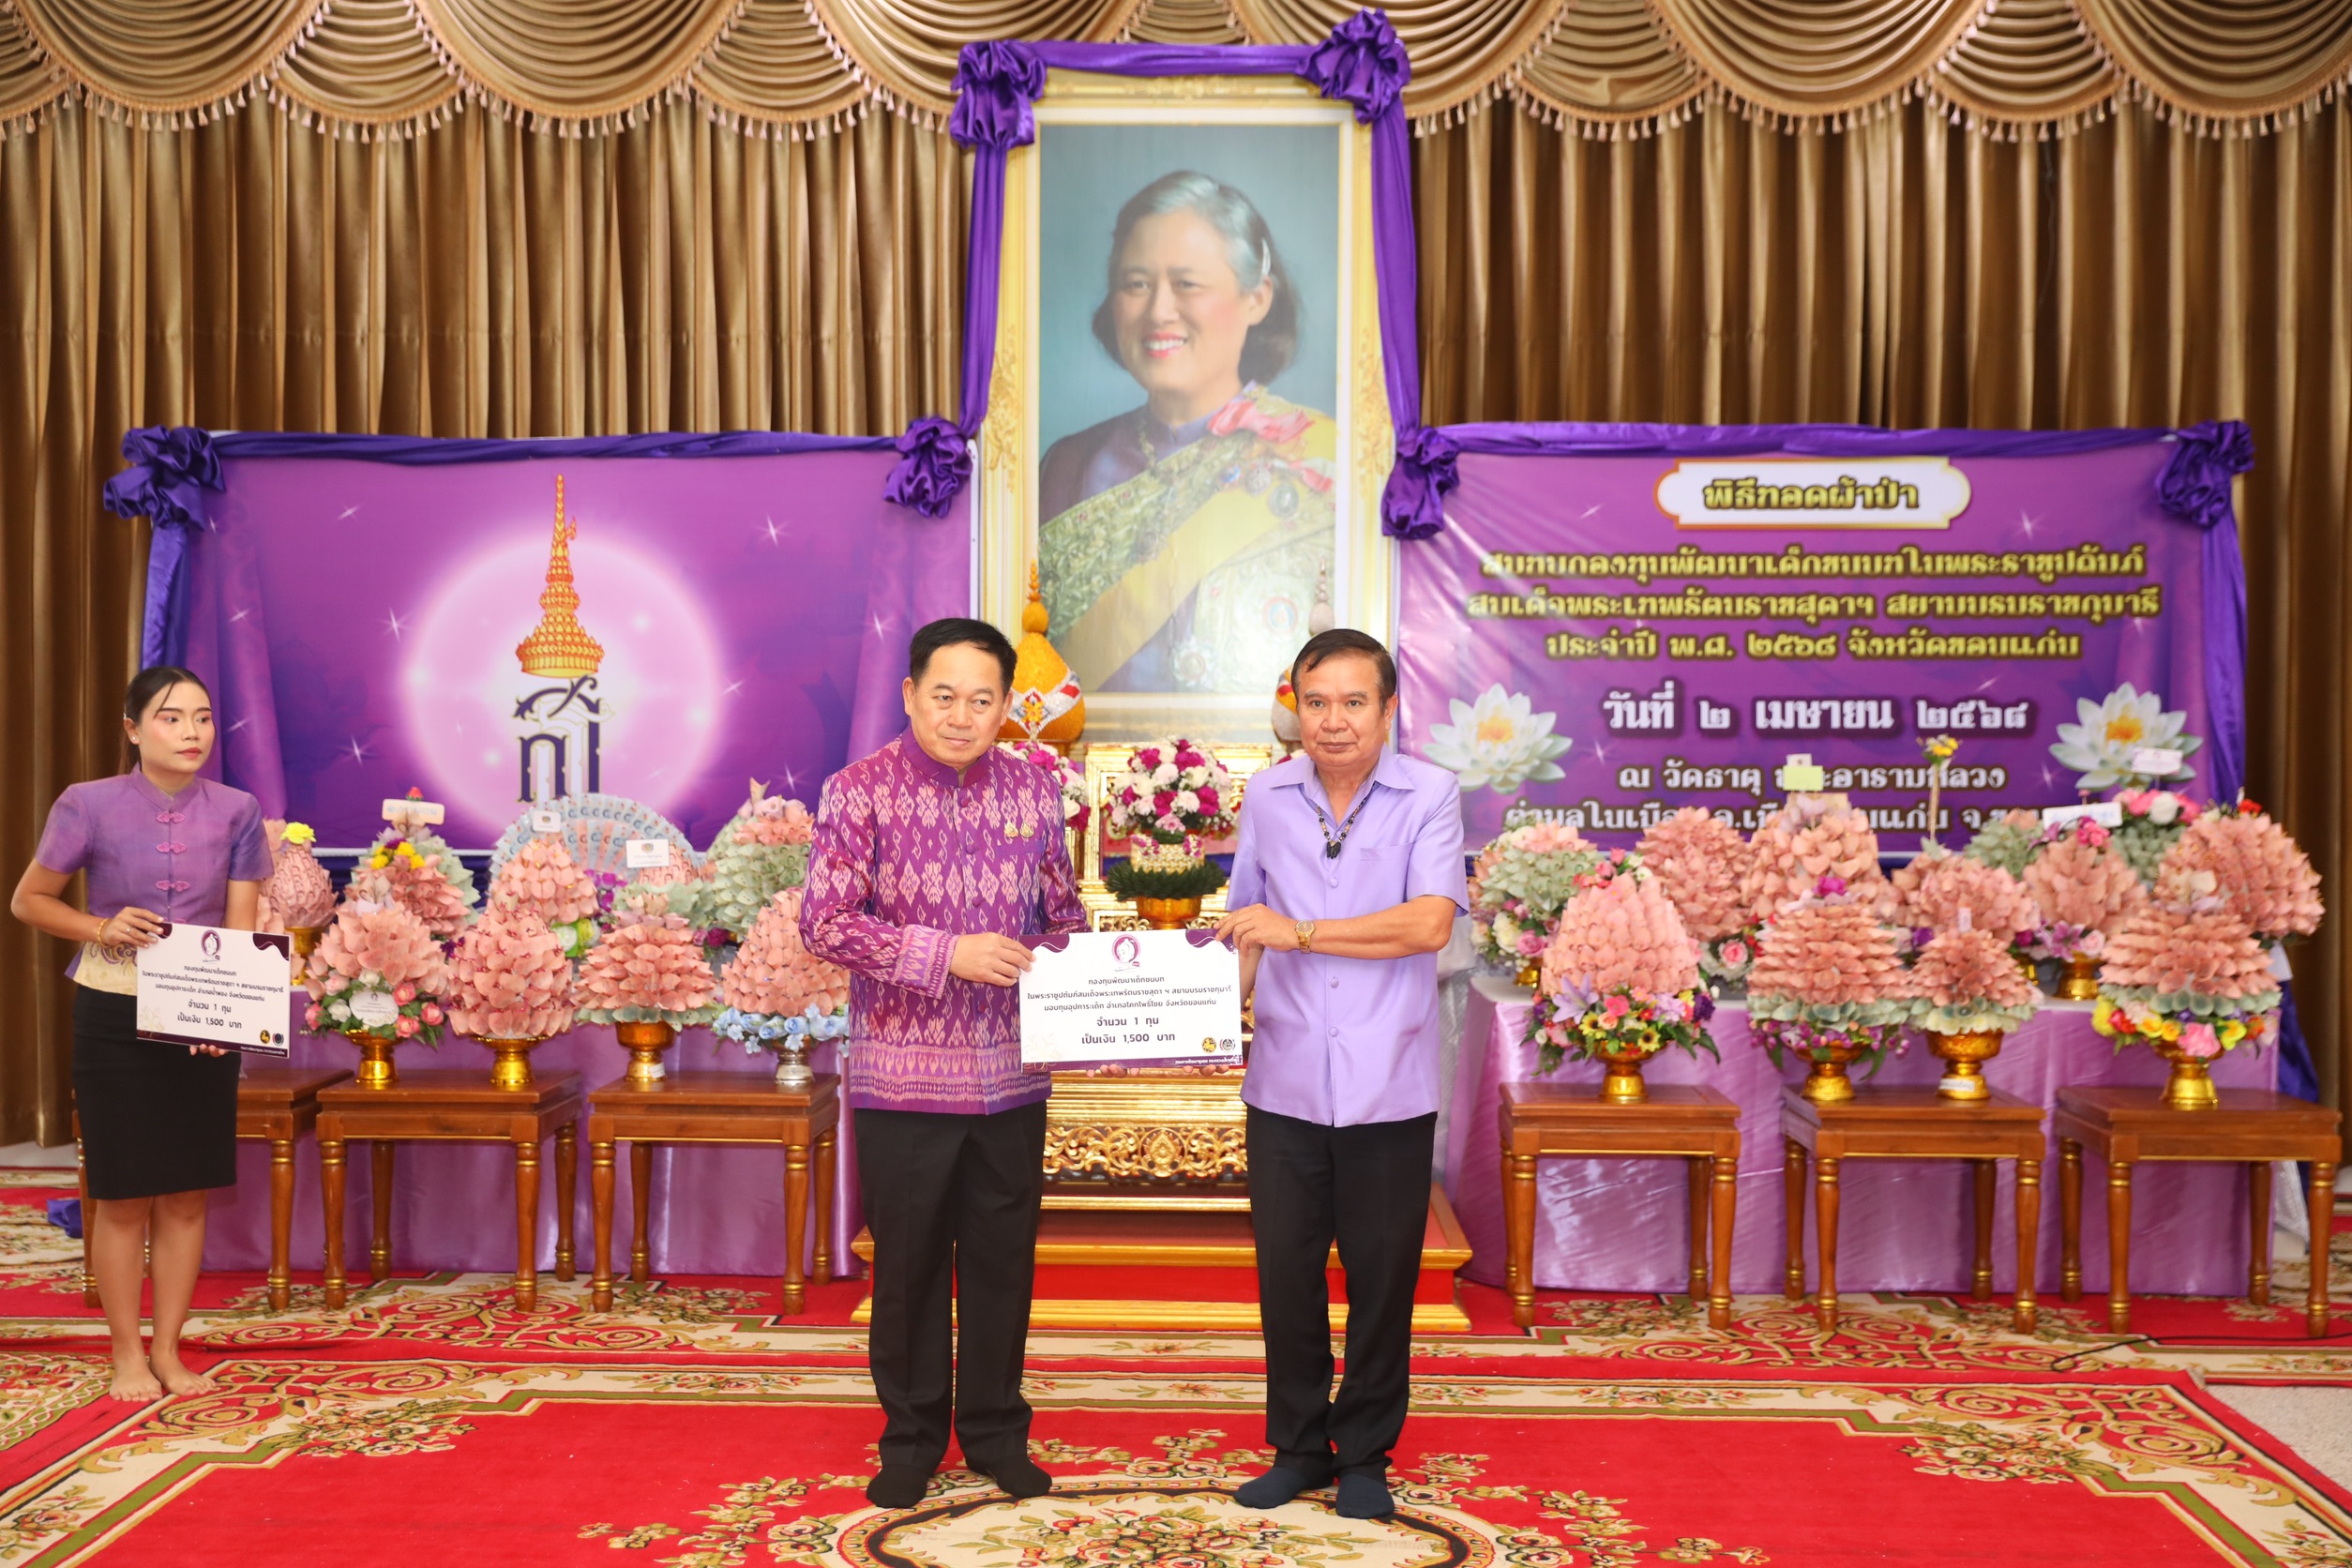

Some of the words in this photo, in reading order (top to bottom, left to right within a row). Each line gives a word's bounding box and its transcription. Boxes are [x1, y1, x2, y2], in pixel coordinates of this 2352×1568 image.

[1703, 475, 1920, 510] พิธีทอดผ้าป่า
[1885, 586, 2161, 622] สยามบรมราชกุมารี
[1545, 627, 1658, 657] ประจำปี
[1669, 634, 1734, 657] พ.ศ.
[1747, 632, 1838, 657] ๒๕๖๘
[1847, 627, 2080, 657] จังหวัดขอนแก่น
[1604, 680, 1675, 729] วันที่
[1699, 700, 1730, 729] ๒
[1755, 700, 1894, 730] เมษายน
[1916, 700, 2029, 730] ๒๕๖๘
[1619, 767, 1651, 789] ณ
[1663, 759, 1762, 795] วัดธาตุ
[177, 1011, 202, 1024] เป็นเงิน
[205, 1017, 224, 1027] 1,500
[228, 1020, 242, 1029] บาท
[188, 999, 210, 1010] จำนวน
[221, 1004, 232, 1015] ทุน
[1096, 1016, 1127, 1027] จำนวน
[1134, 1017, 1138, 1025] 1
[1145, 1017, 1159, 1028] ทุน
[1081, 1033, 1116, 1045] เป็นเงิน
[1123, 1033, 1150, 1044] 1,500
[1156, 1033, 1176, 1042] บาท
